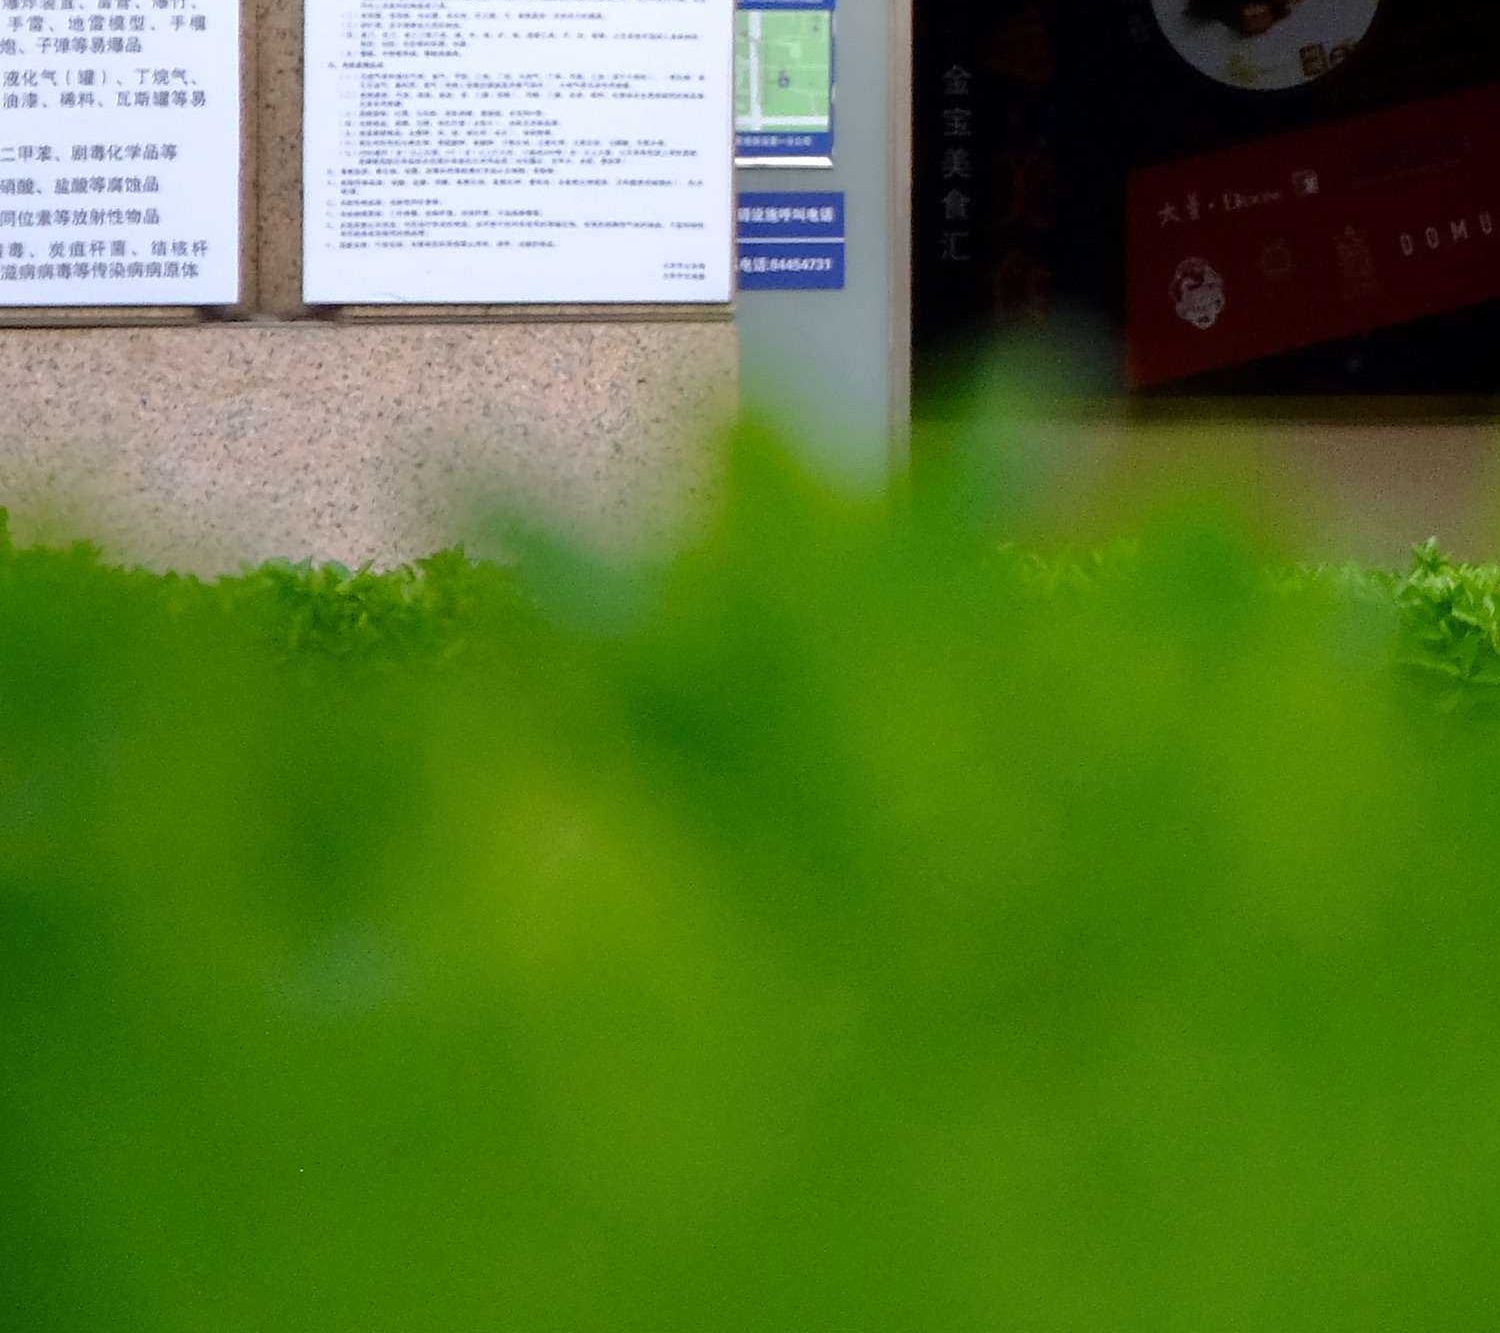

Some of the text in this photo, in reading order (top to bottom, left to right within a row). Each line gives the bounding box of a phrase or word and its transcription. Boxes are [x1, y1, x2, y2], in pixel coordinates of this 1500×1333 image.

[939, 63, 975, 262] 金宝美食汇
